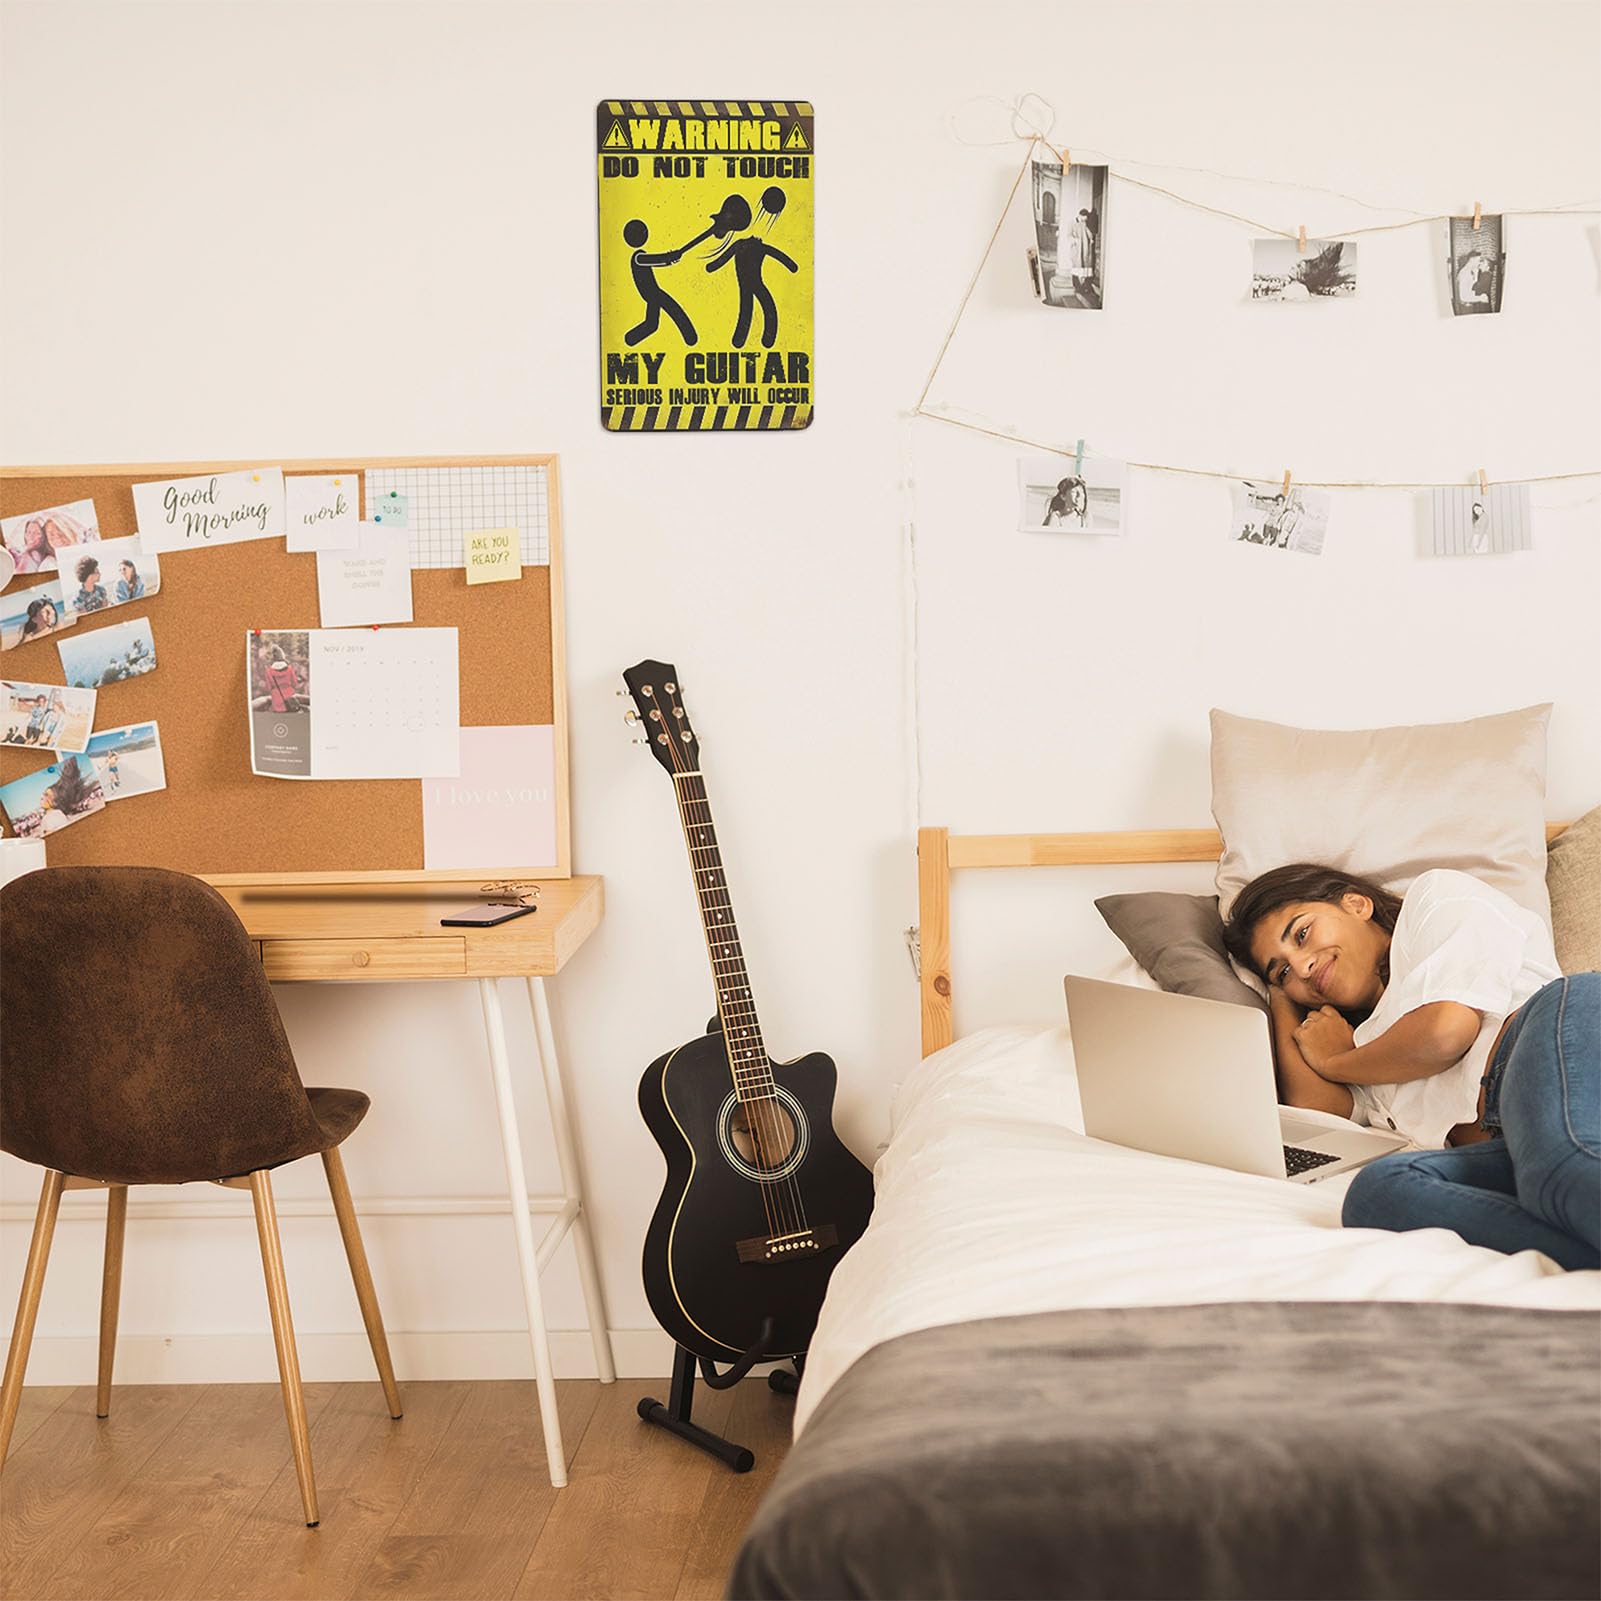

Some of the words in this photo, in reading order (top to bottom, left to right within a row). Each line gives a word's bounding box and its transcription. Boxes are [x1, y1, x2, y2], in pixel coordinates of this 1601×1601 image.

[629, 119, 782, 151] WARNING
[603, 156, 639, 178] DO
[654, 156, 708, 178] NOT
[723, 156, 809, 178] TOUCH
[607, 352, 666, 385] MY
[685, 352, 809, 385] GUITAR
[607, 388, 663, 405] SERIOUS
[669, 388, 721, 405] INJURY
[727, 388, 761, 405] WILL
[767, 387, 809, 404] OCCUR
[163, 477, 220, 524] Good
[303, 493, 348, 525] work
[183, 503, 271, 539] Morning
[471, 536, 489, 549] ARE
[491, 535, 509, 548] YOU
[471, 550, 510, 565] READY?
[435, 787, 441, 804] I
[450, 786, 499, 805] love
[503, 787, 549, 808] you
